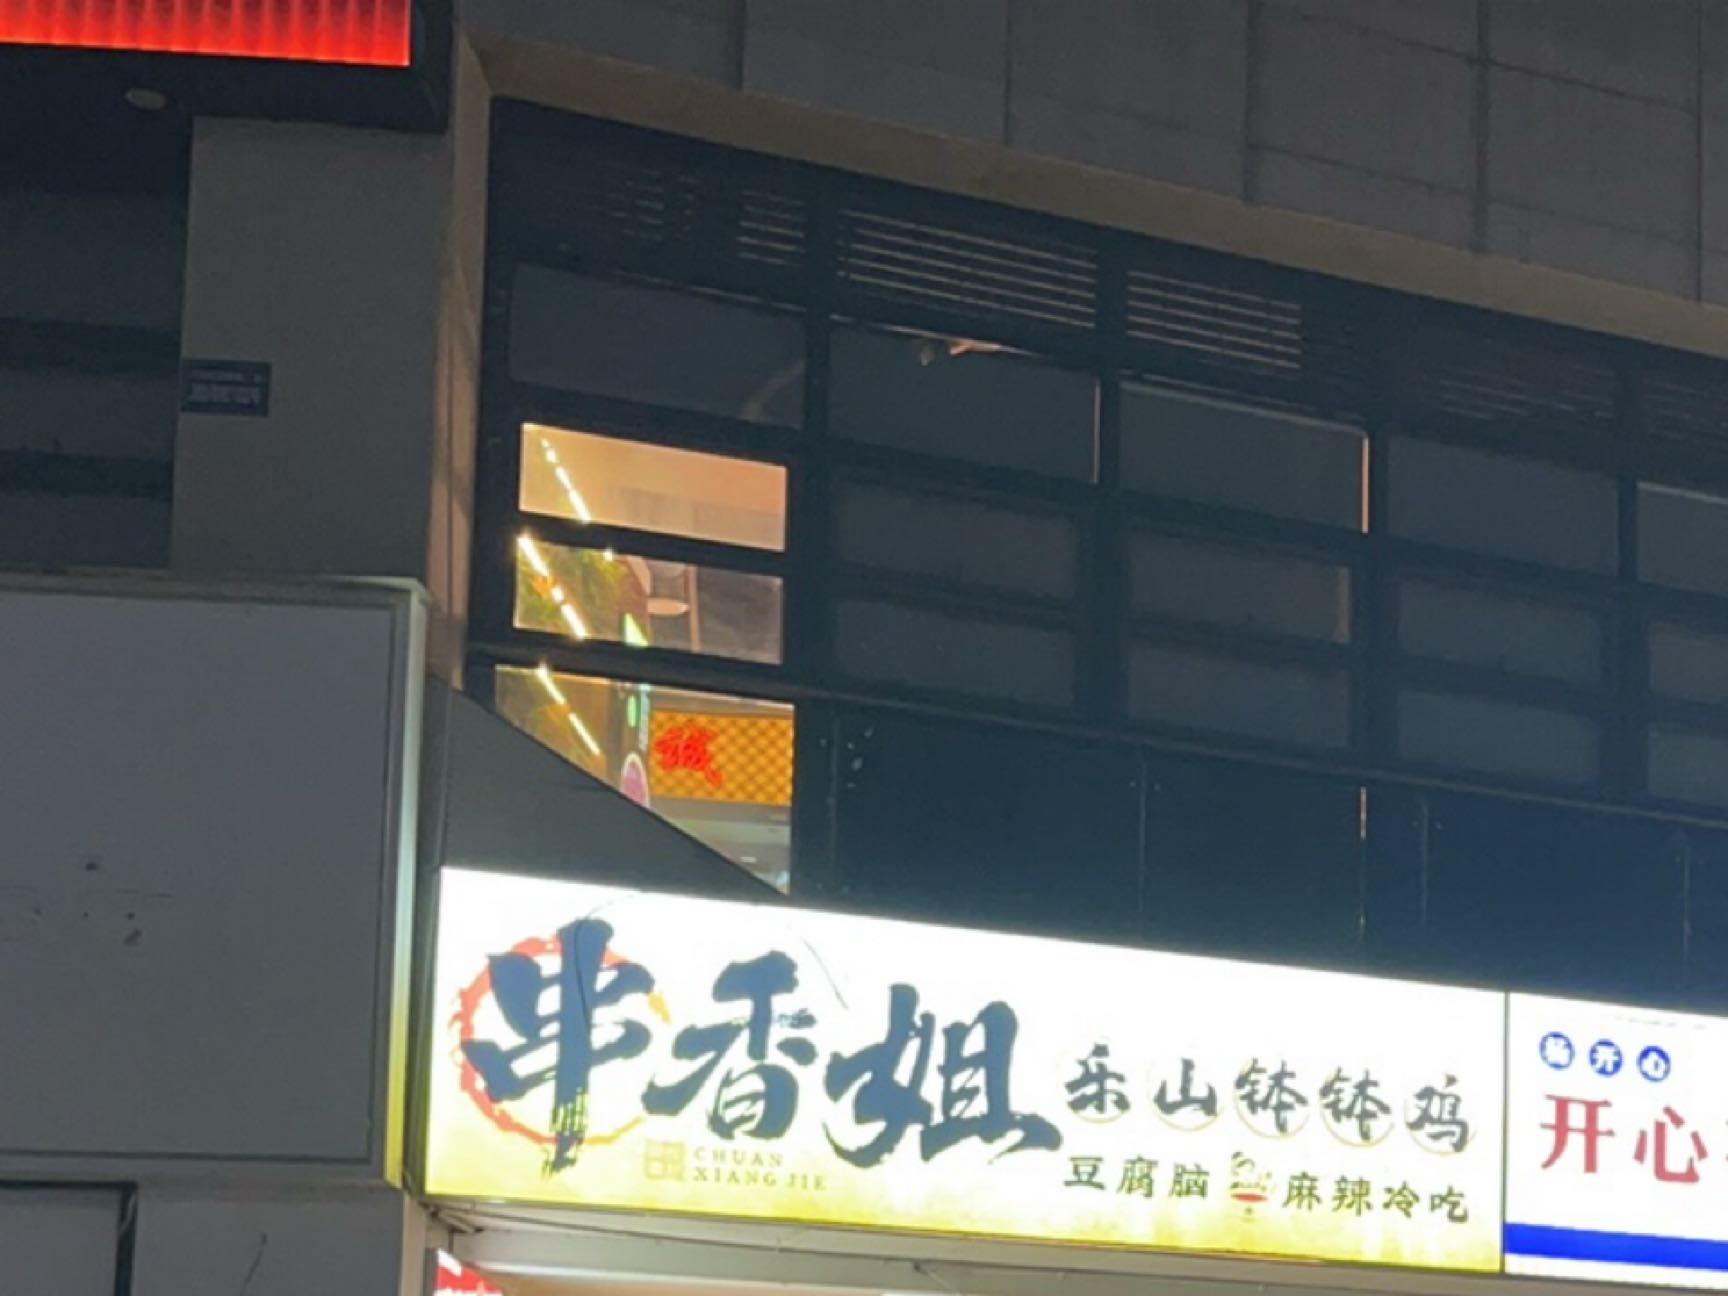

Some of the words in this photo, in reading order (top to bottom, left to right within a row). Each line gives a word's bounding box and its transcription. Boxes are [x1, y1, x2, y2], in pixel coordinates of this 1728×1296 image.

[461, 918, 1064, 1180] 串香姐
[1063, 1042, 1470, 1153] 乐山钵钵鸡
[693, 1145, 784, 1167] CHUAN
[693, 1166, 777, 1187] XIANG
[787, 1173, 827, 1191] JIE
[1063, 1154, 1211, 1199] 豆腐脑
[1282, 1172, 1470, 1224] 麻辣冷吃
